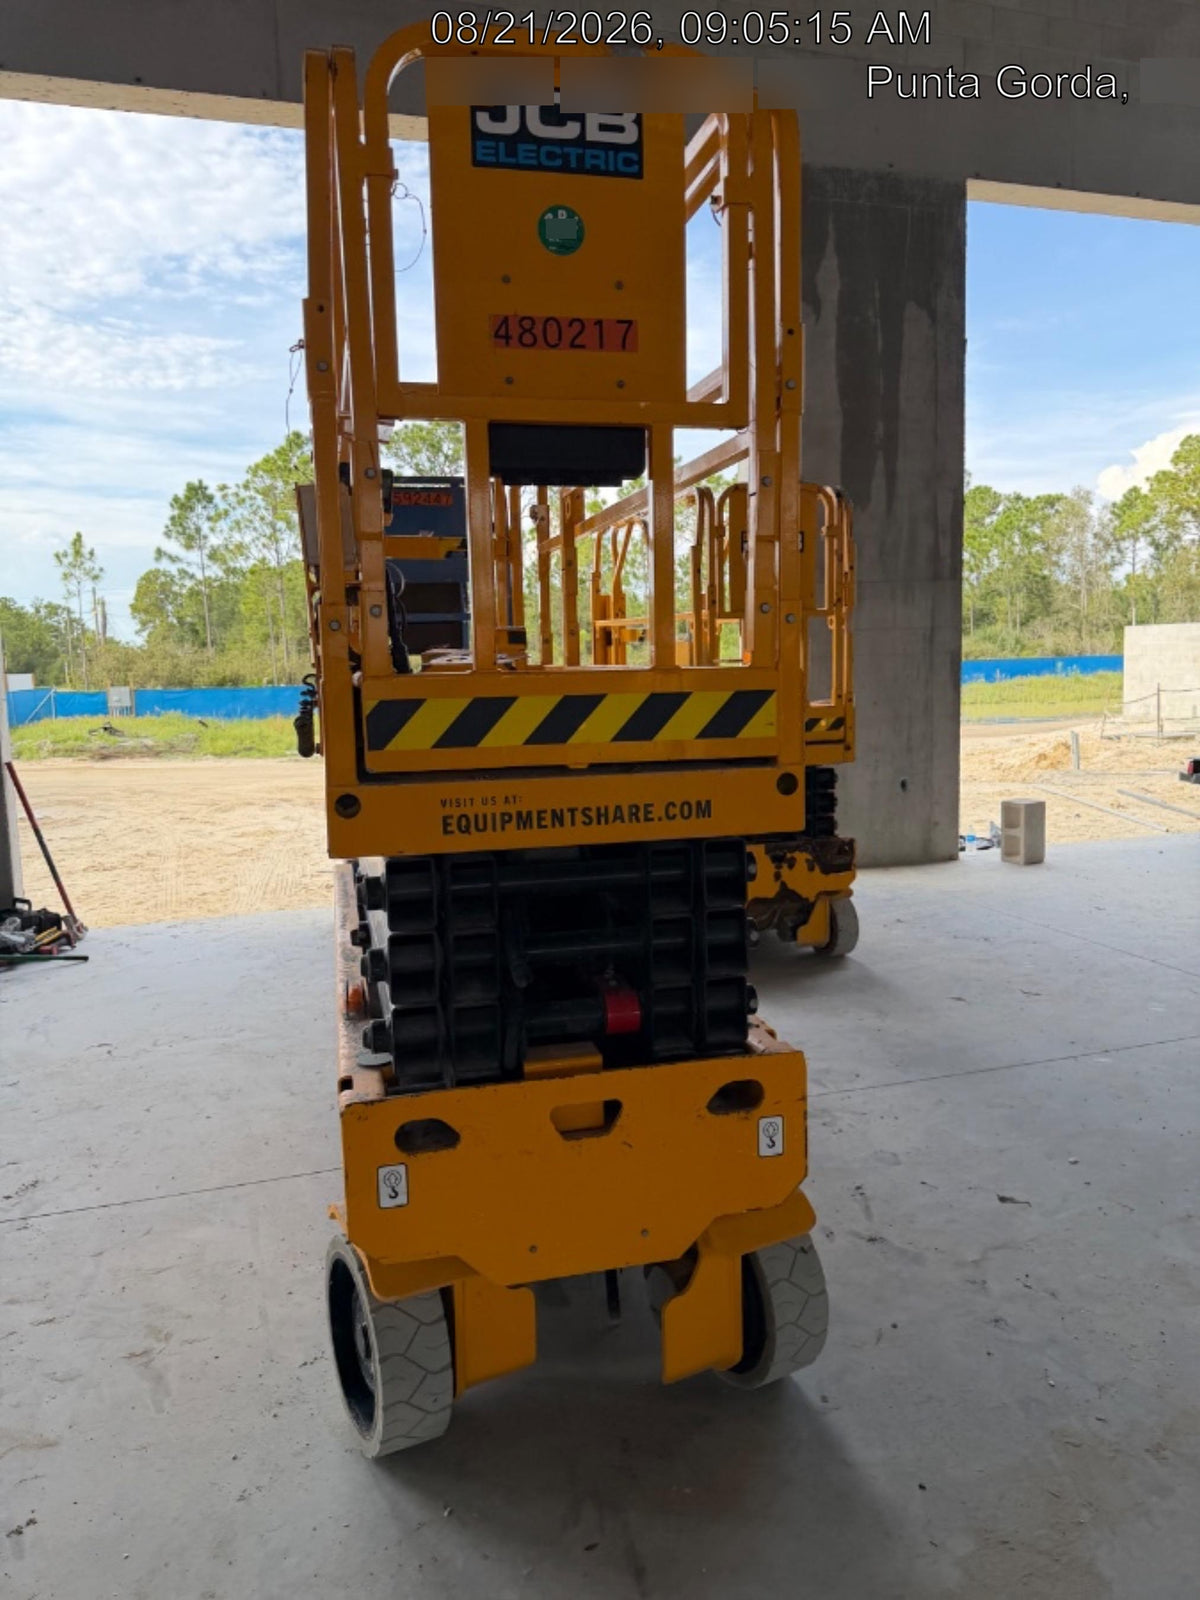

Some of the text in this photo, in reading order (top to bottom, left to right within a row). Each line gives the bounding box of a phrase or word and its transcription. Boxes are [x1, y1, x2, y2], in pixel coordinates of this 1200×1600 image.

[476, 104, 640, 145] JCB
[475, 140, 640, 173] ELECTRIC
[493, 315, 634, 350] 480217
[440, 797, 475, 808] VISIT
[481, 796, 497, 806] US
[441, 799, 713, 836] EQUIPMENTSHARE.COM
